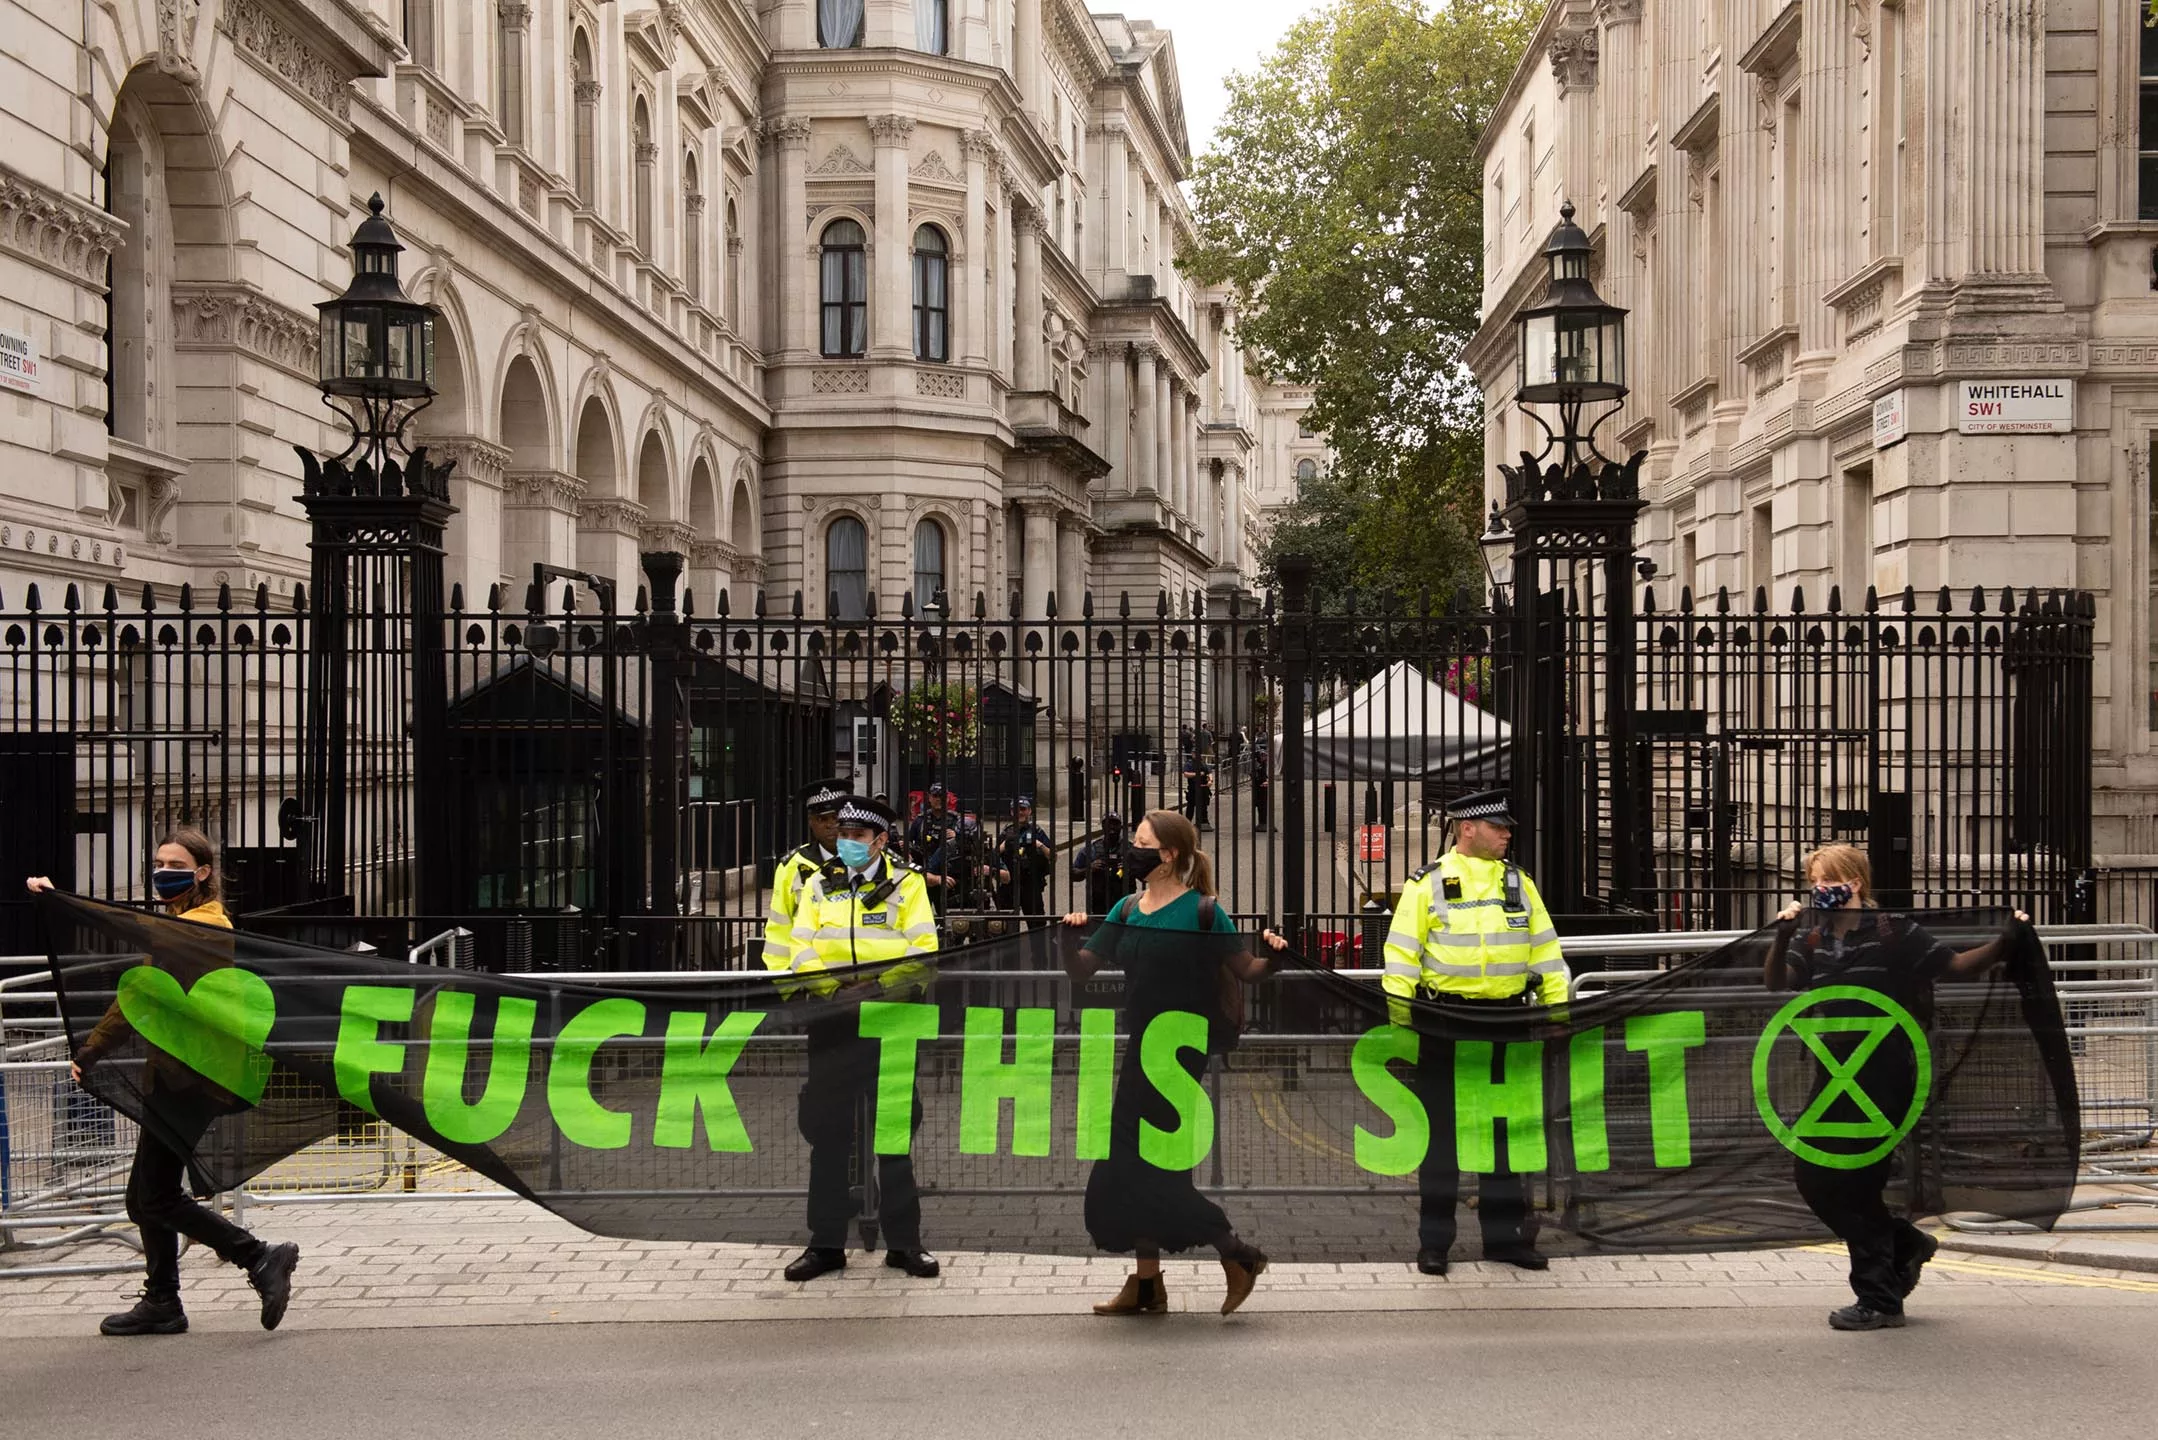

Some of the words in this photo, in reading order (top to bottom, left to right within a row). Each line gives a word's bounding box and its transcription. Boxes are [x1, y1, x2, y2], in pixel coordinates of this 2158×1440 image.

[0, 333, 28, 355] OWNING
[0, 351, 20, 371] TREET
[23, 359, 37, 376] SW1
[1968, 385, 2064, 399] WHITEHALL
[1968, 402, 2002, 416] SW1
[1968, 423, 1985, 431] CITY
[1986, 423, 1996, 431] OF
[1999, 422, 2053, 431] WESTMINSTER
[332, 984, 767, 1154] FUCK
[857, 1000, 1215, 1172] THIS
[1350, 1010, 1707, 1176] SHIT
